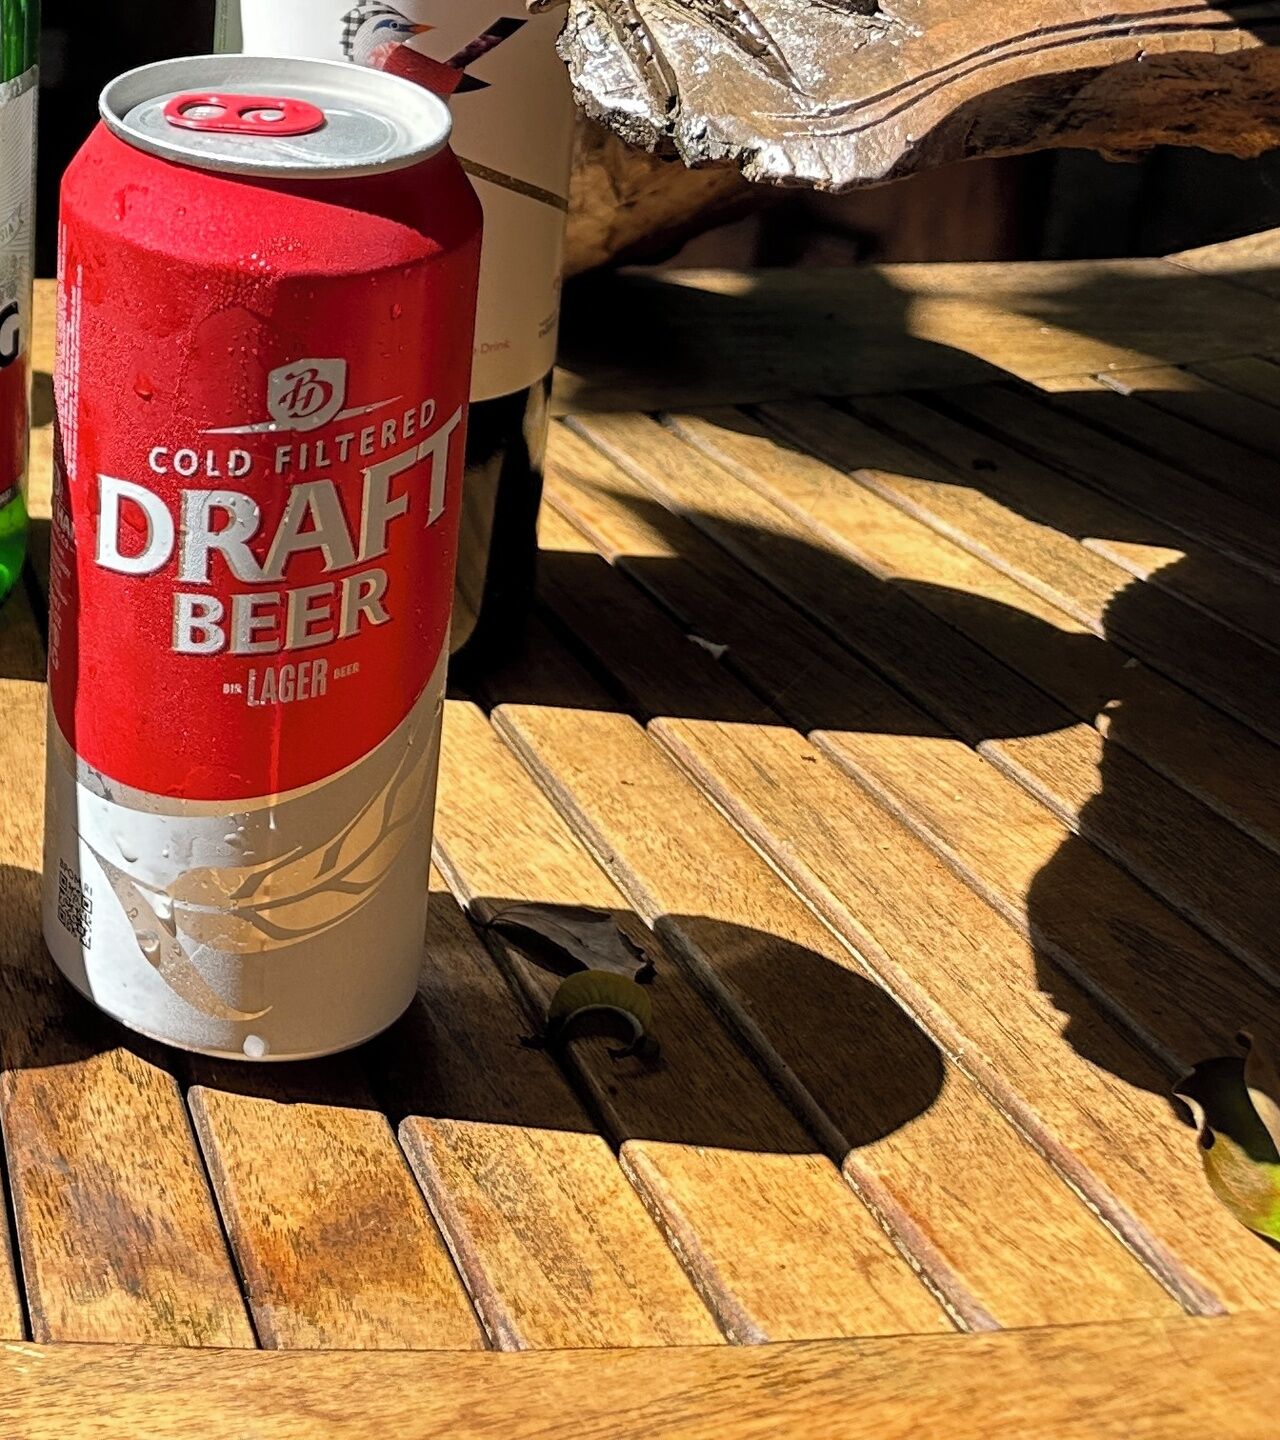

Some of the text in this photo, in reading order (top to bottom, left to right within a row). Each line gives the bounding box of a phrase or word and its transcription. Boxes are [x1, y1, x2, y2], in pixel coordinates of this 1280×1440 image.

[148, 398, 437, 477] COLD FILTERED
[94, 405, 464, 586] DRAFT
[171, 569, 392, 656] BEER
[247, 658, 328, 707] LAGER
[333, 662, 360, 680] BEER
